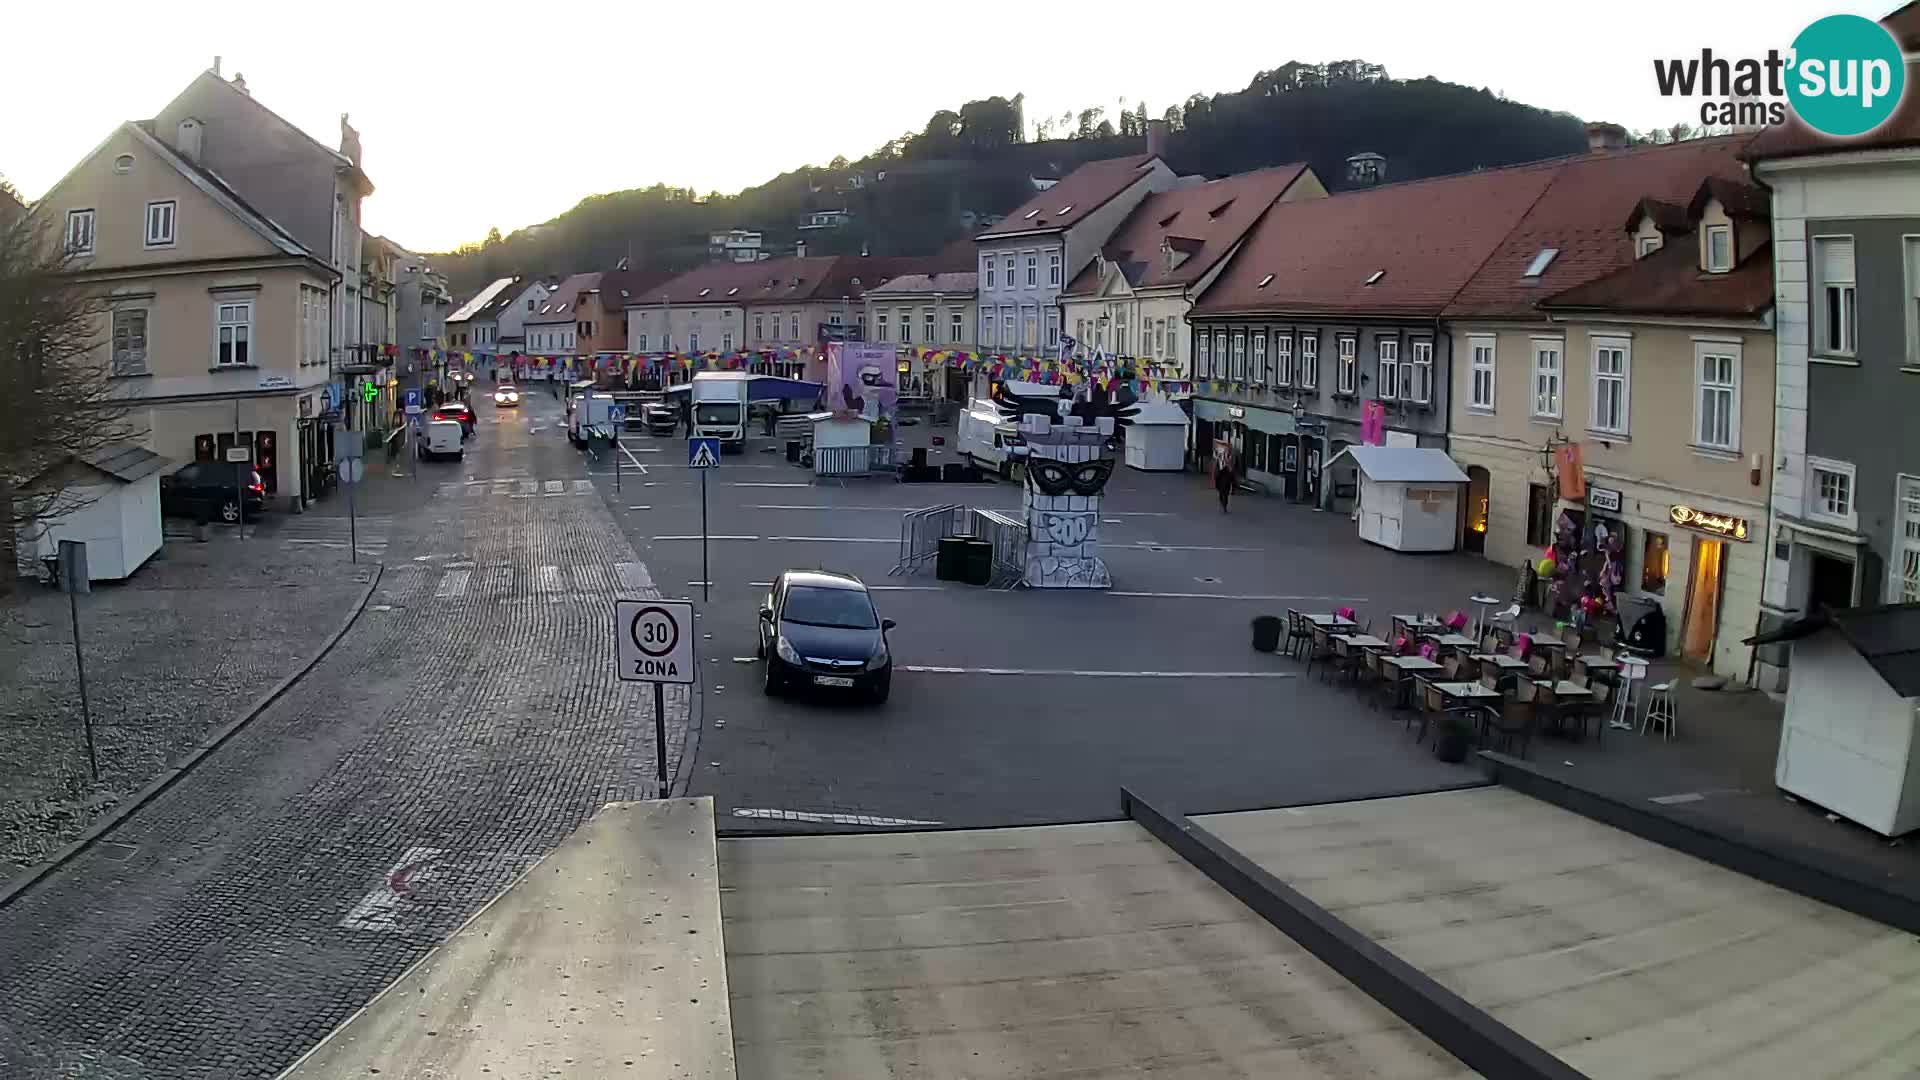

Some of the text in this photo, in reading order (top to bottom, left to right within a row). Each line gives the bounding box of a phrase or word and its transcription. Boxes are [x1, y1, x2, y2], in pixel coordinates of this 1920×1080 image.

[408, 391, 417, 404] P
[1048, 516, 1088, 545] 200
[643, 622, 667, 643] 30
[634, 659, 678, 676] ZONA
